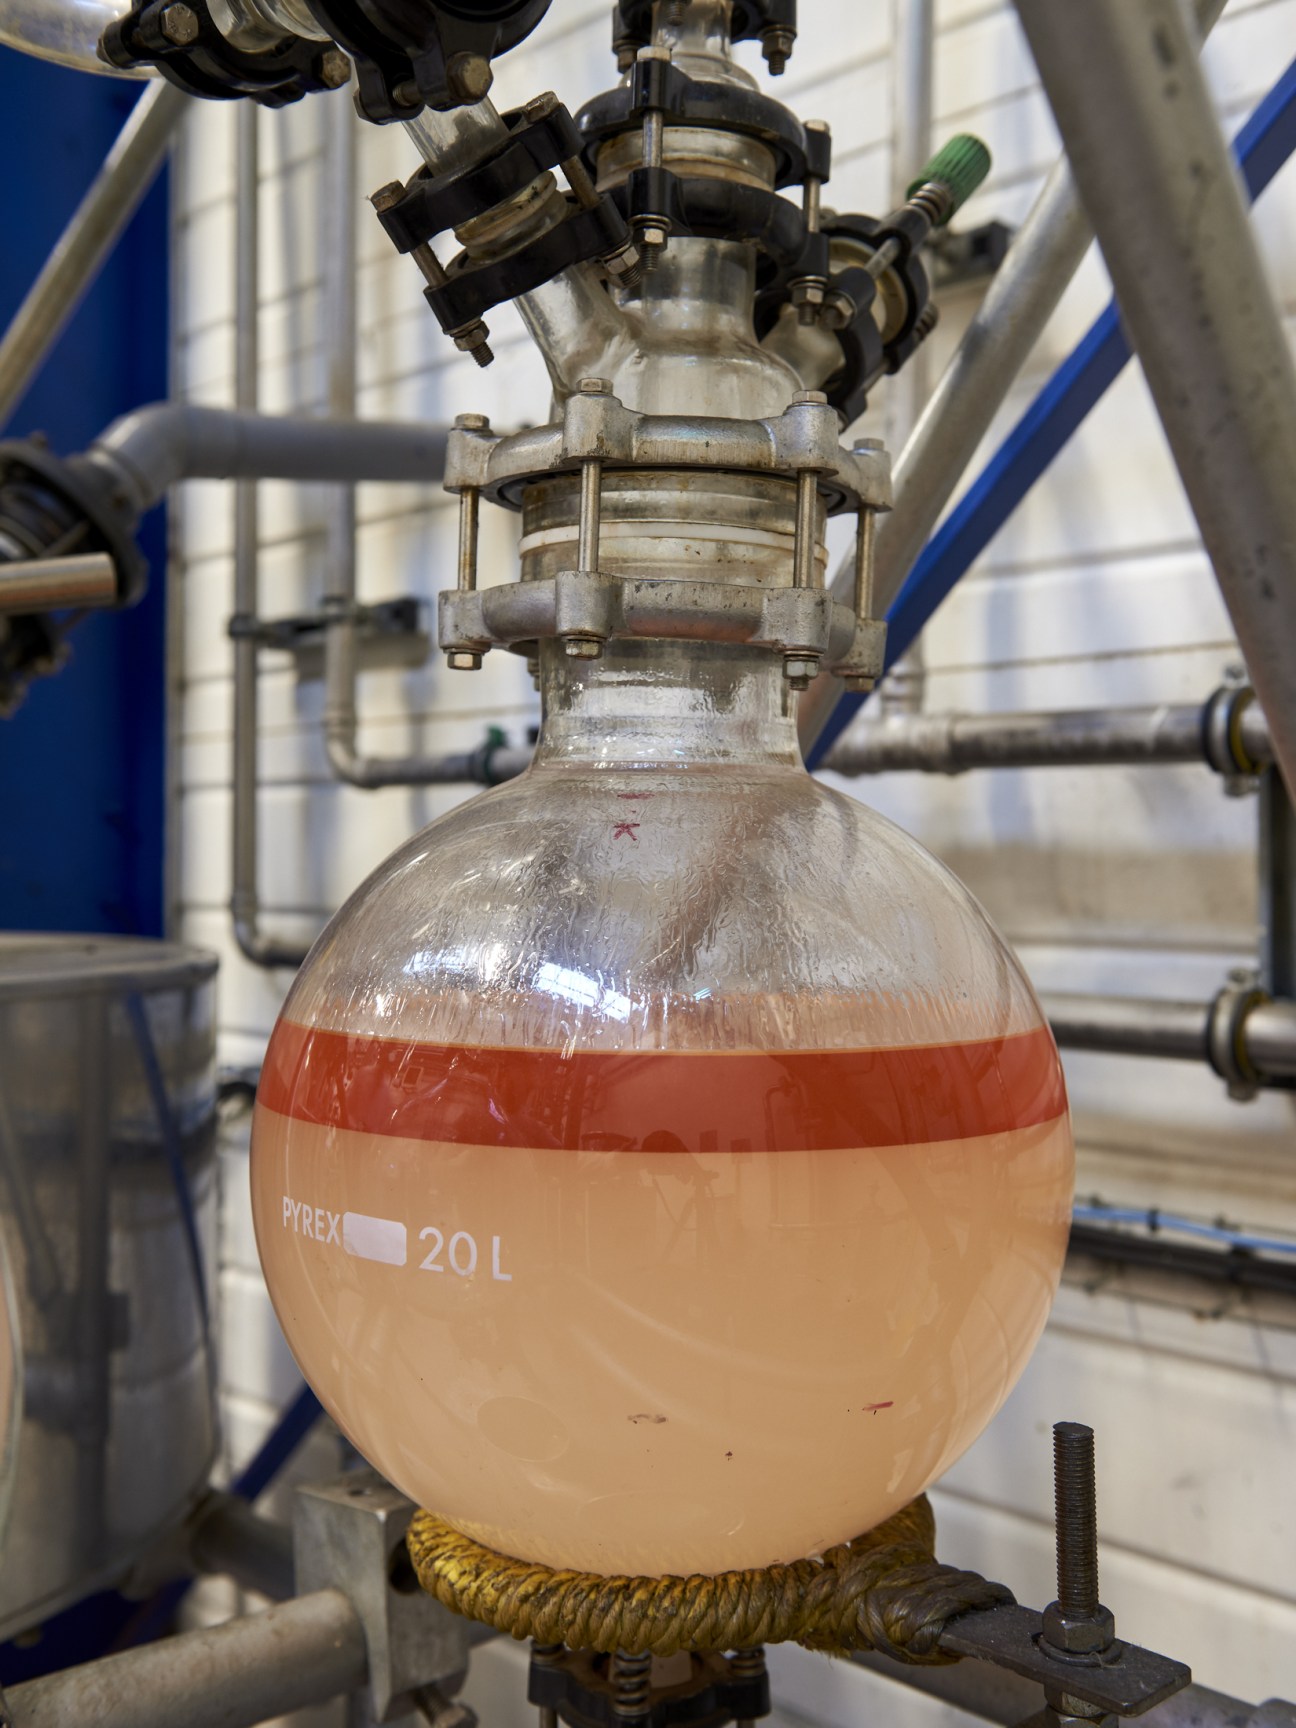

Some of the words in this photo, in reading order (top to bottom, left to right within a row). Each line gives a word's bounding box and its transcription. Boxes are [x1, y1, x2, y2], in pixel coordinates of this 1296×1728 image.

[283, 1196, 341, 1245] PYREX
[419, 1227, 478, 1276] 20
[492, 1236, 513, 1281] L
